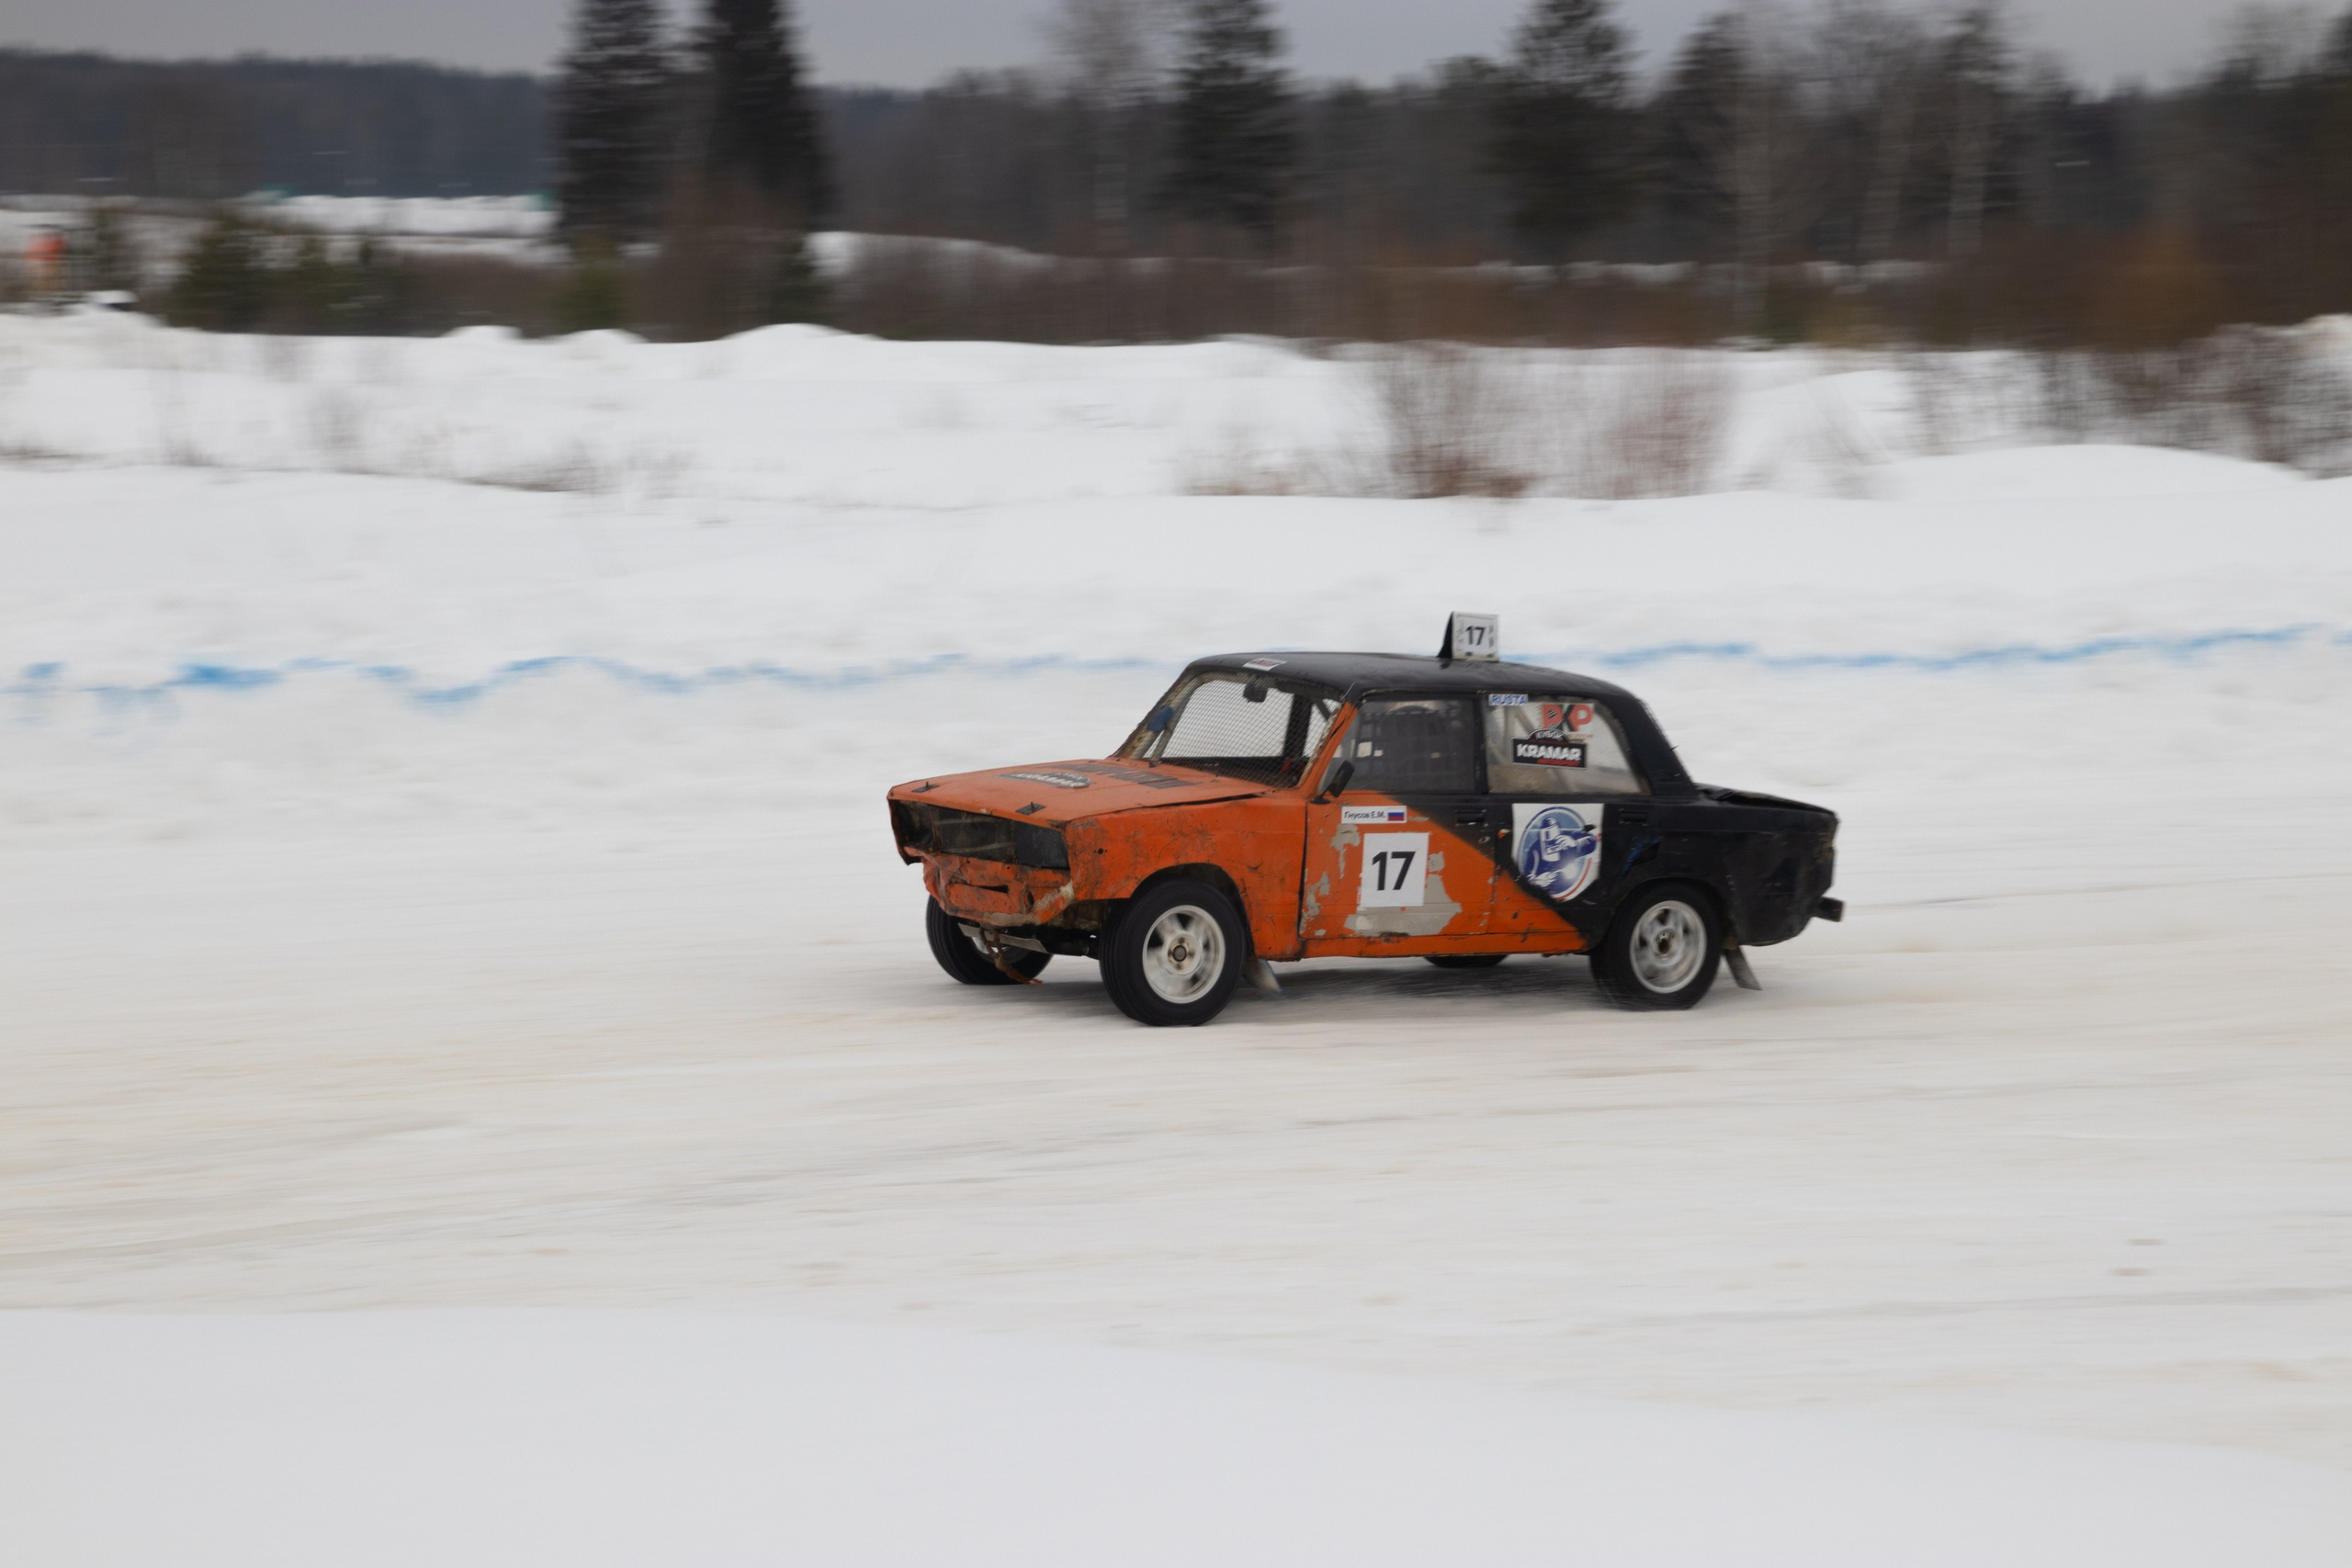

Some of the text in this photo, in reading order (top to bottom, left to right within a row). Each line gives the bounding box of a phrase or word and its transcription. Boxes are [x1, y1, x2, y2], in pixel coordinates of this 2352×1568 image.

[1465, 626, 1487, 646] 17
[1490, 694, 1527, 705] RUSTA
[1516, 743, 1582, 761] KRAMAR
[1372, 851, 1417, 891] 17
